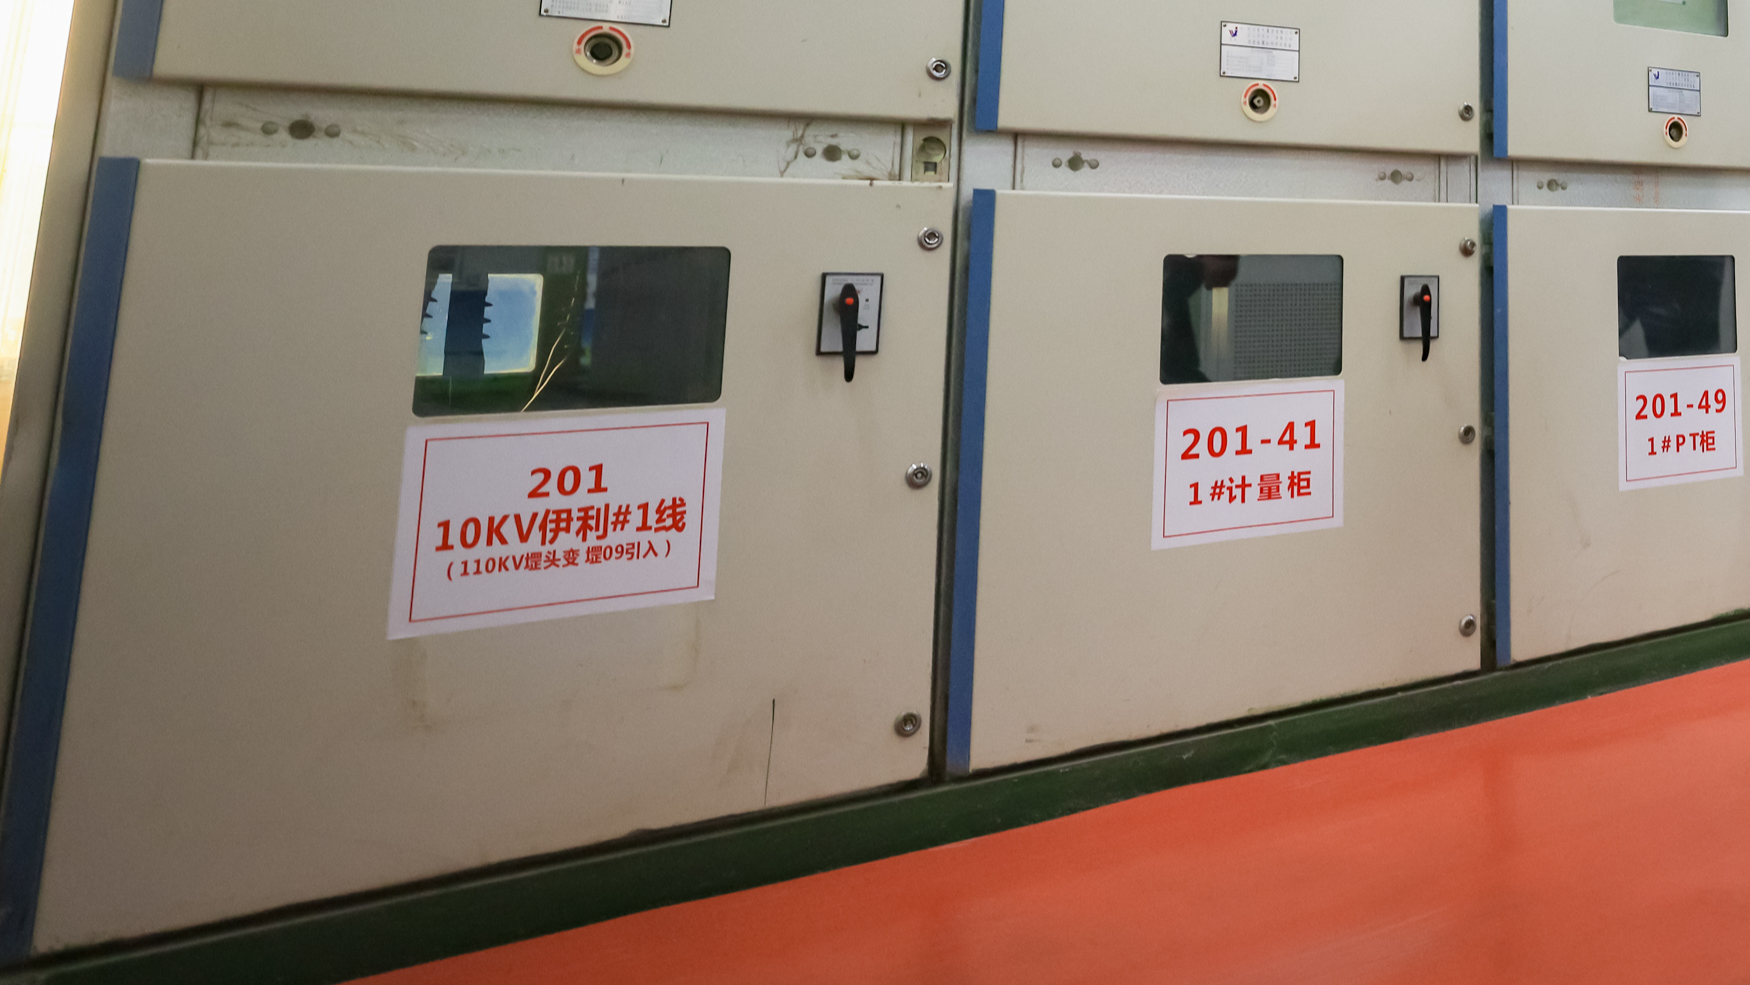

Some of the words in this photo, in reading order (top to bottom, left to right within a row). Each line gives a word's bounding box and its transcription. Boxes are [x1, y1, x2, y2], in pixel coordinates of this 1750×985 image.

[1635, 388, 1727, 420] 201-49
[1180, 419, 1321, 460] 201-41
[1647, 430, 1716, 456] 1#PT柜
[526, 463, 609, 499] 201
[1188, 470, 1312, 506] 1#计量柜
[434, 497, 687, 553] 10KV伊利#1线
